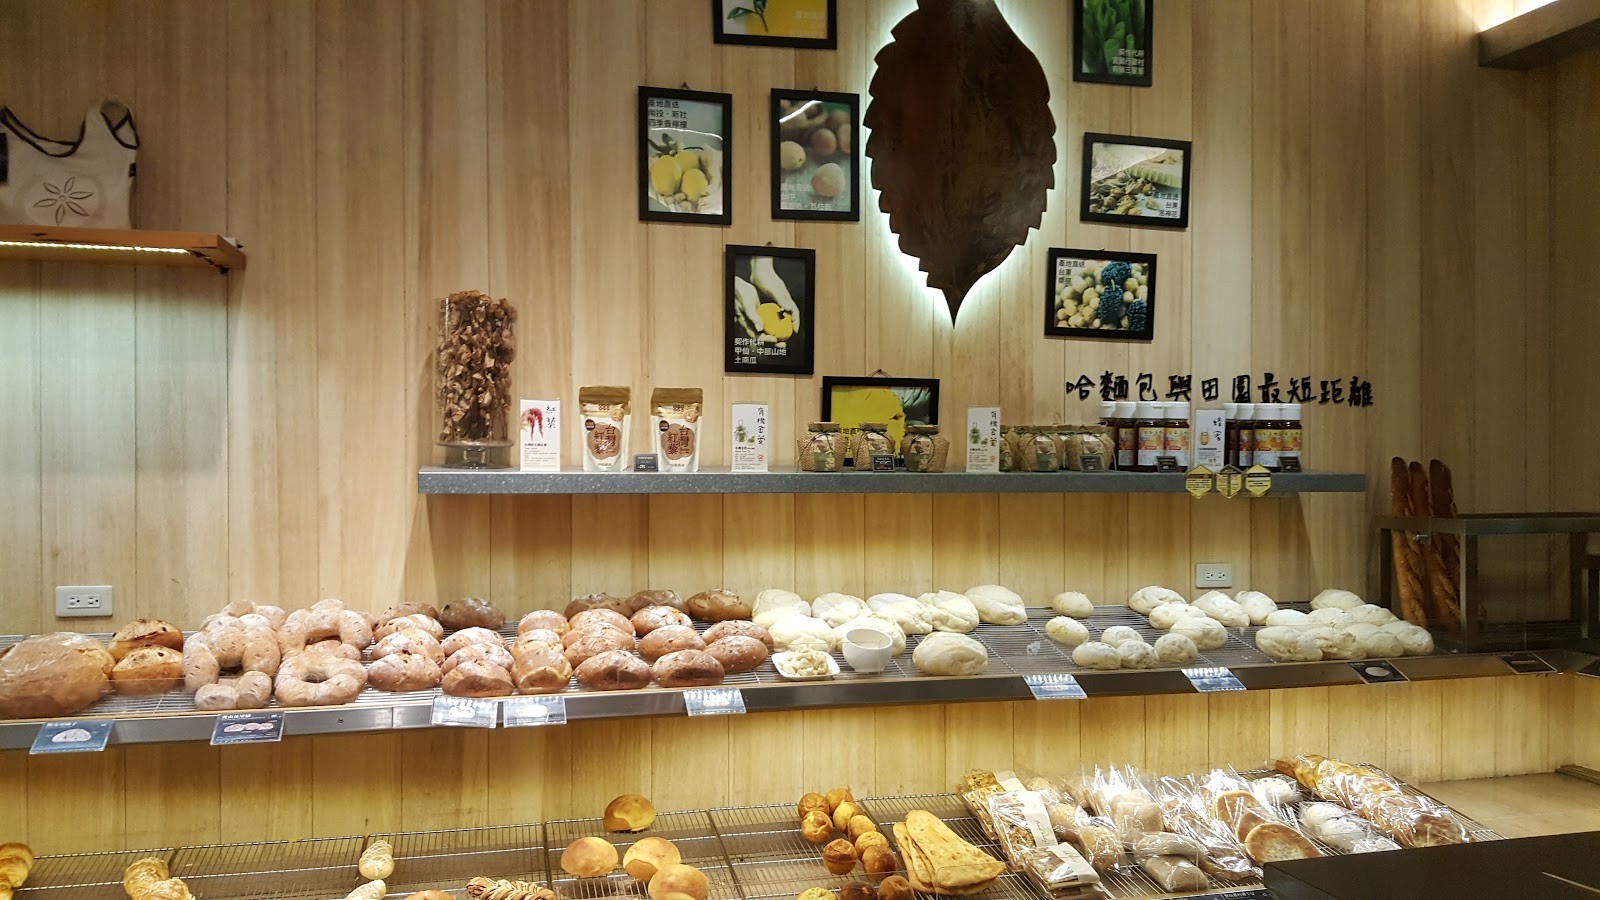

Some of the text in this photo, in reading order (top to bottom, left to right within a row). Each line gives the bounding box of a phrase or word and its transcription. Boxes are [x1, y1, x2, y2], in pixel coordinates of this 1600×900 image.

[648, 100, 680, 108] 產地直送
[1152, 192, 1179, 200] 產地直送
[1165, 201, 1178, 209] 台東
[1058, 260, 1085, 268] 產地直送
[734, 337, 765, 346] 契作代耕
[734, 356, 757, 364] 土南瓜
[757, 407, 766, 445] 有機金萱
[679, 425, 690, 448] 台灣
